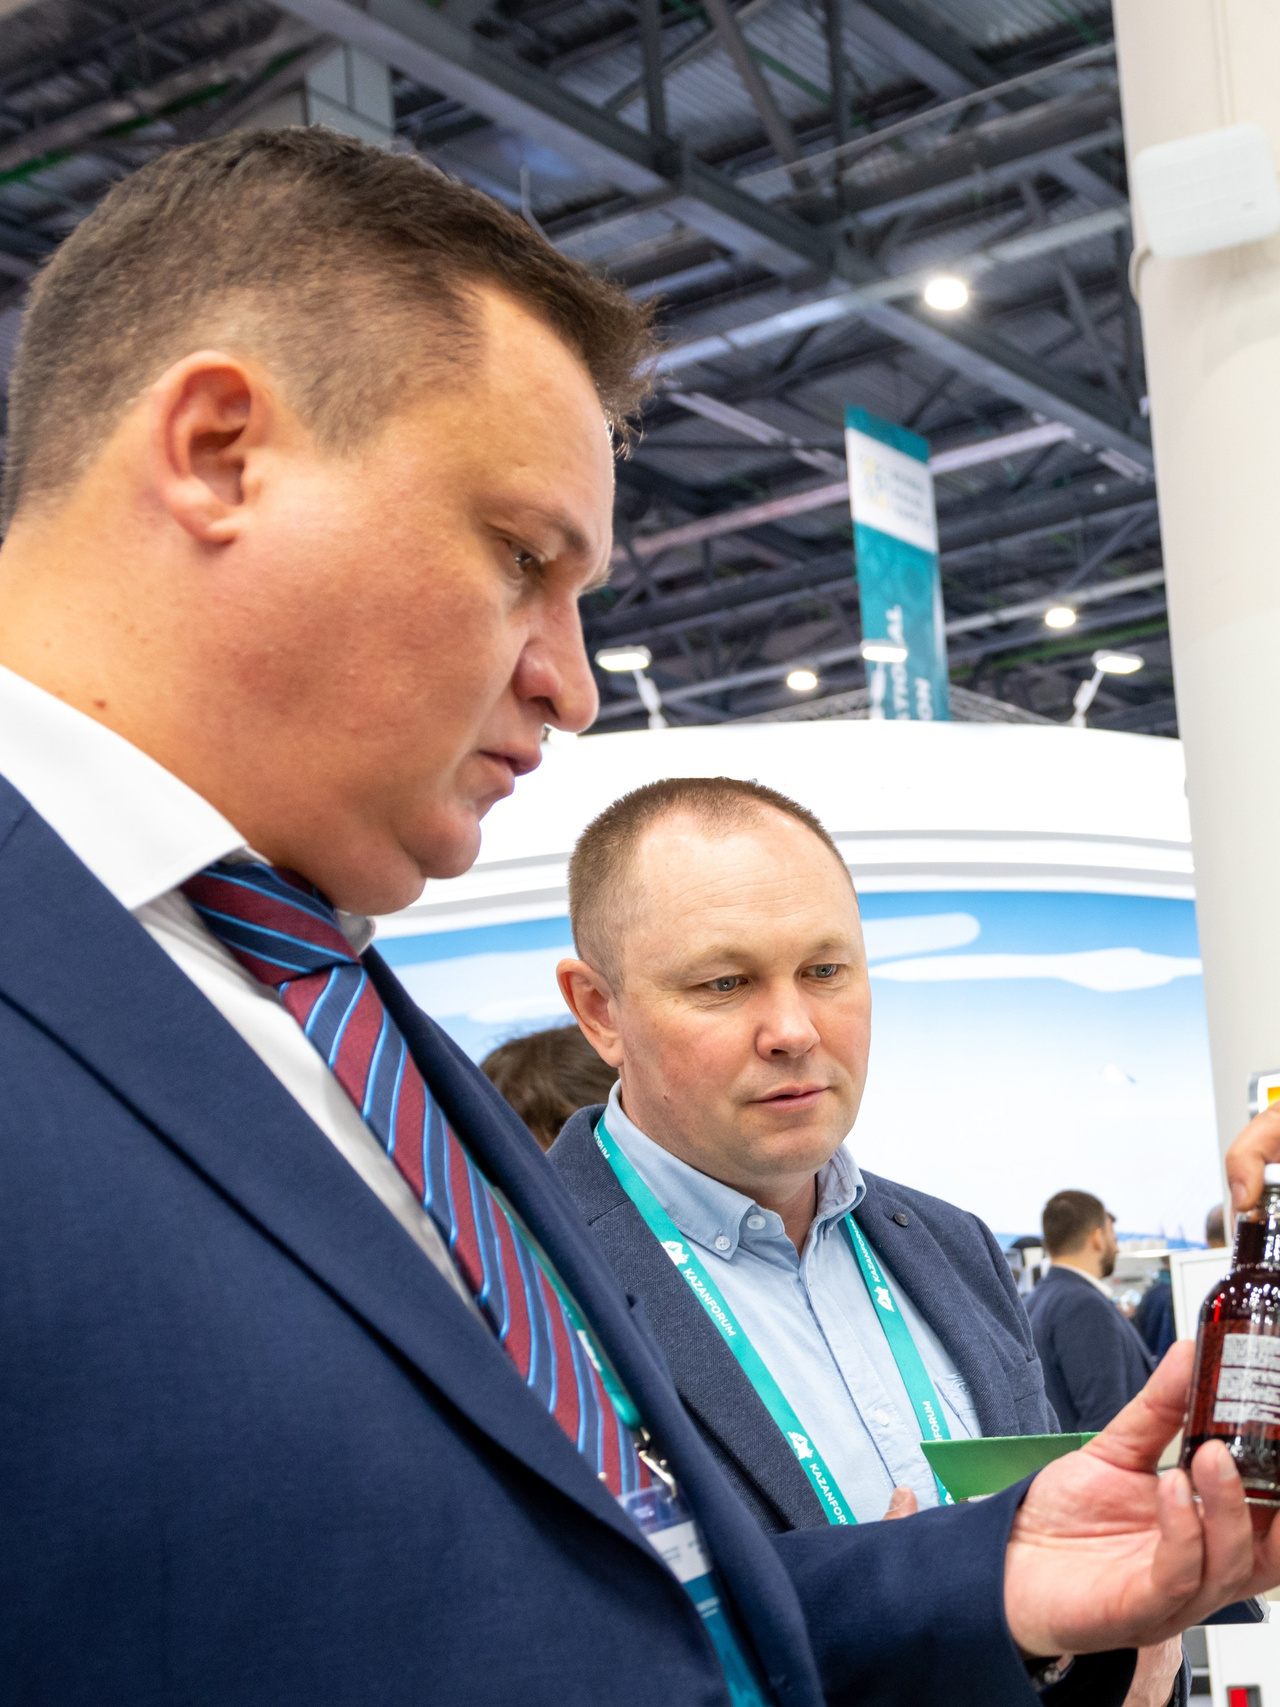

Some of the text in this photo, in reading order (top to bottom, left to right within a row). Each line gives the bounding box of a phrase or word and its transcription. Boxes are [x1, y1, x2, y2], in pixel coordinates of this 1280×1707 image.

[682, 1268, 737, 1337] KAZANFORUM
[922, 1400, 943, 1441] FORUM
[809, 1463, 849, 1526] KAZANFOR
